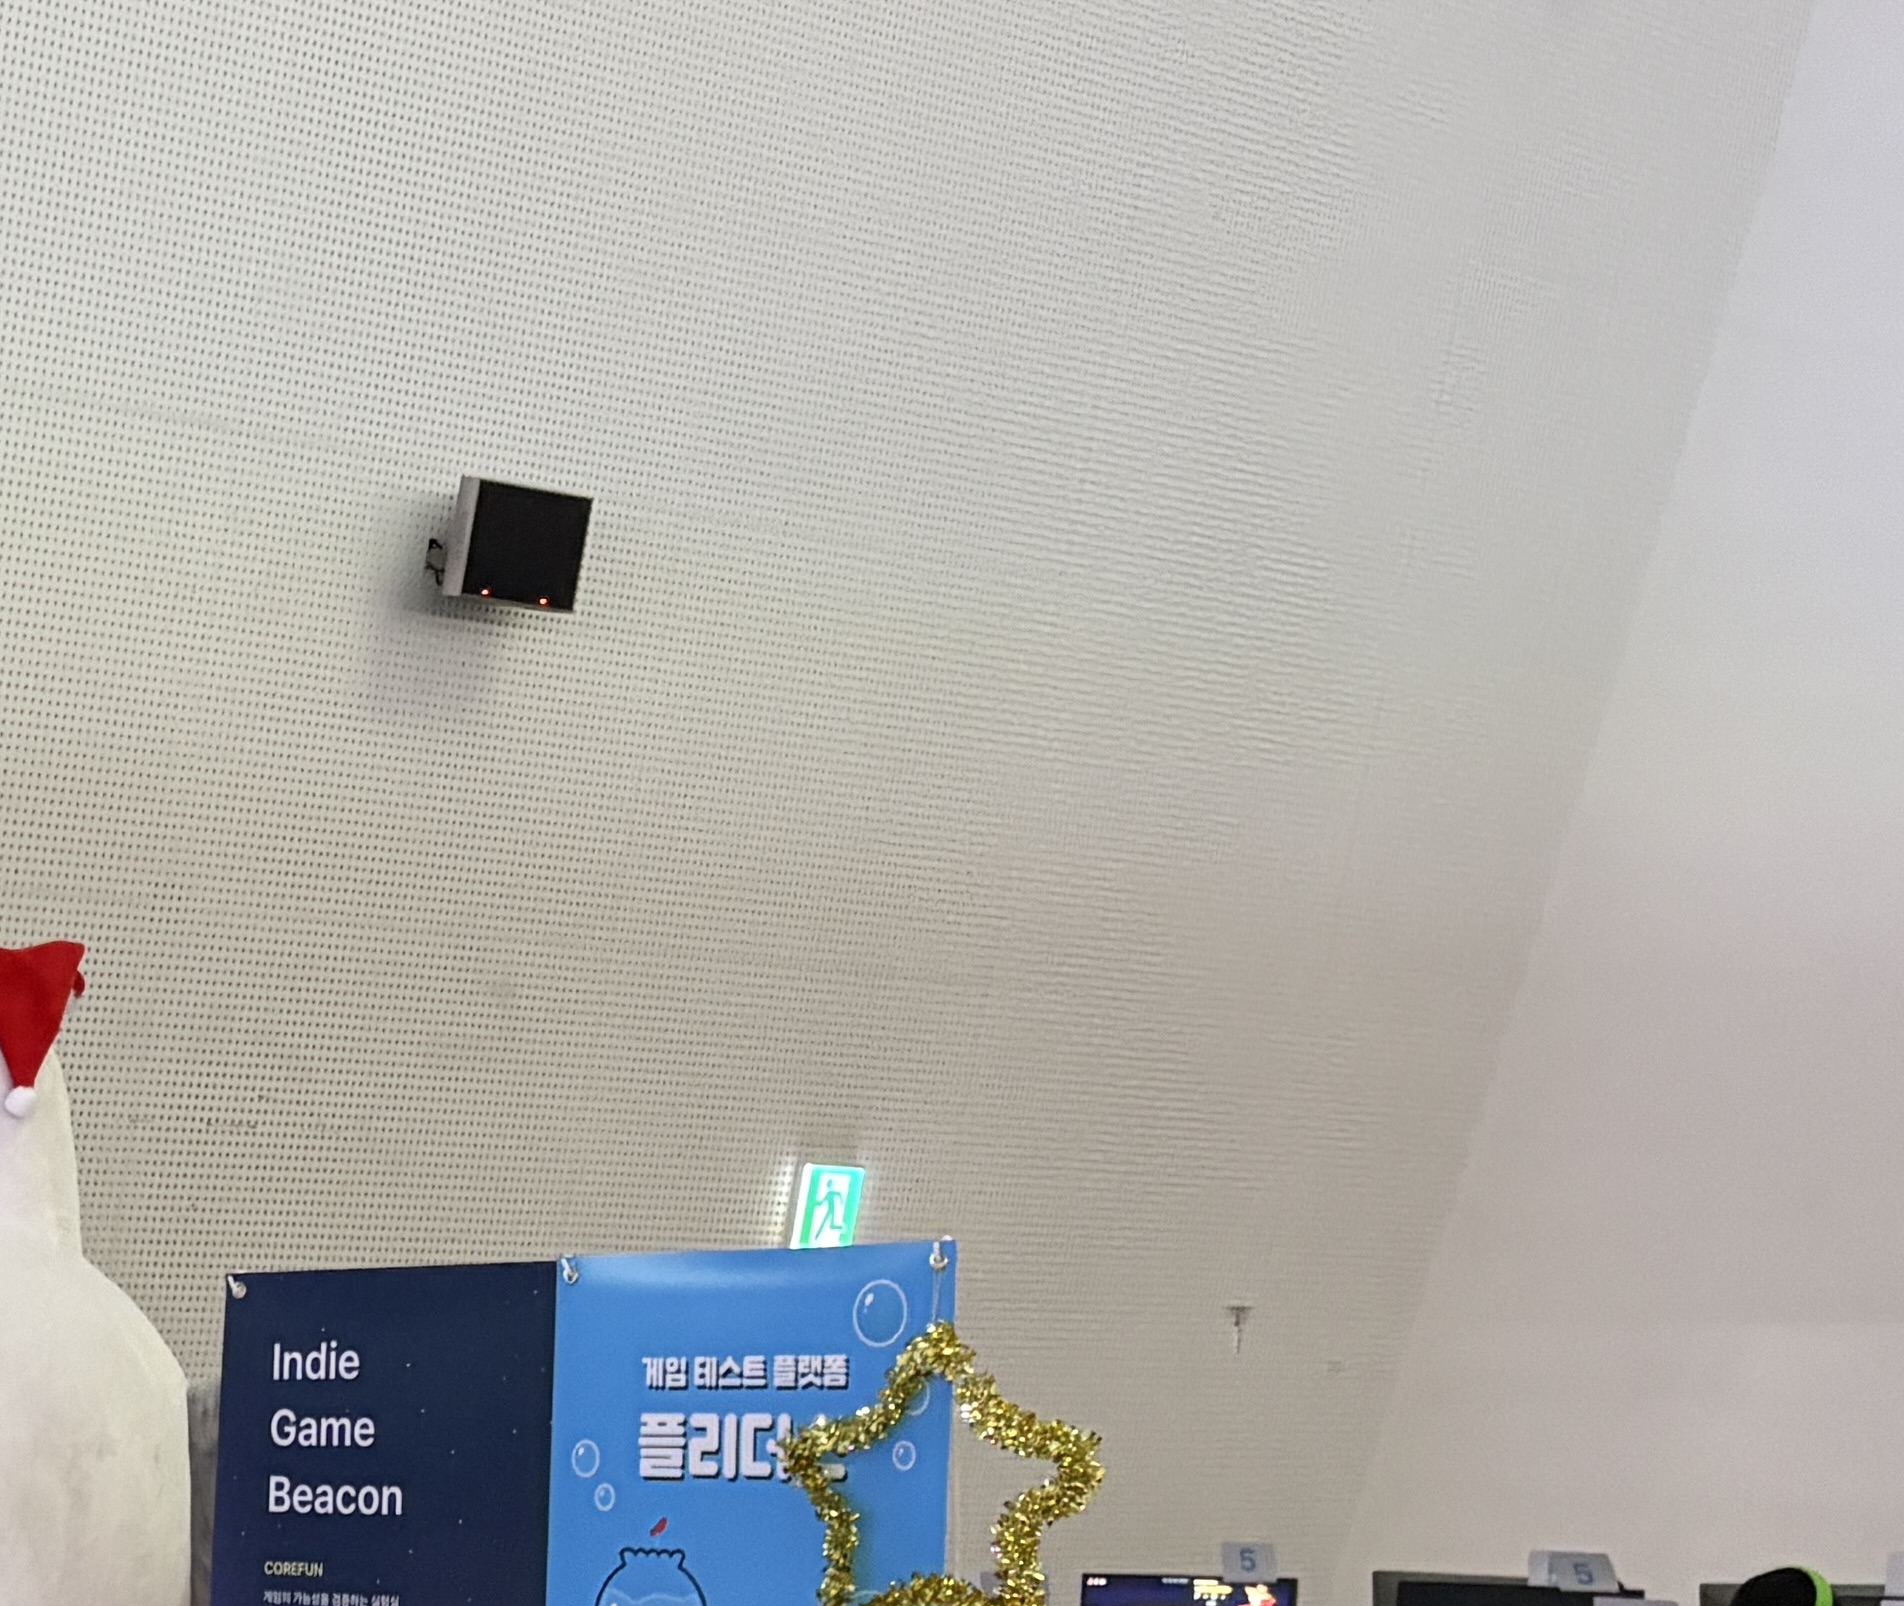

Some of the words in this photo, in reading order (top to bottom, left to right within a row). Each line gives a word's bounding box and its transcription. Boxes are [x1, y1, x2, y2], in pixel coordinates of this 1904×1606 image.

[271, 1341, 360, 1381] Indie
[642, 1357, 686, 1387] 게임
[694, 1356, 766, 1387] 테스트
[773, 1354, 848, 1387] 플랫폼
[270, 1408, 375, 1447] Game
[638, 1413, 846, 1478] 플리더
[268, 1475, 403, 1515] Beacon
[264, 1561, 323, 1577] COREFUN
[1239, 1548, 1256, 1571] 5
